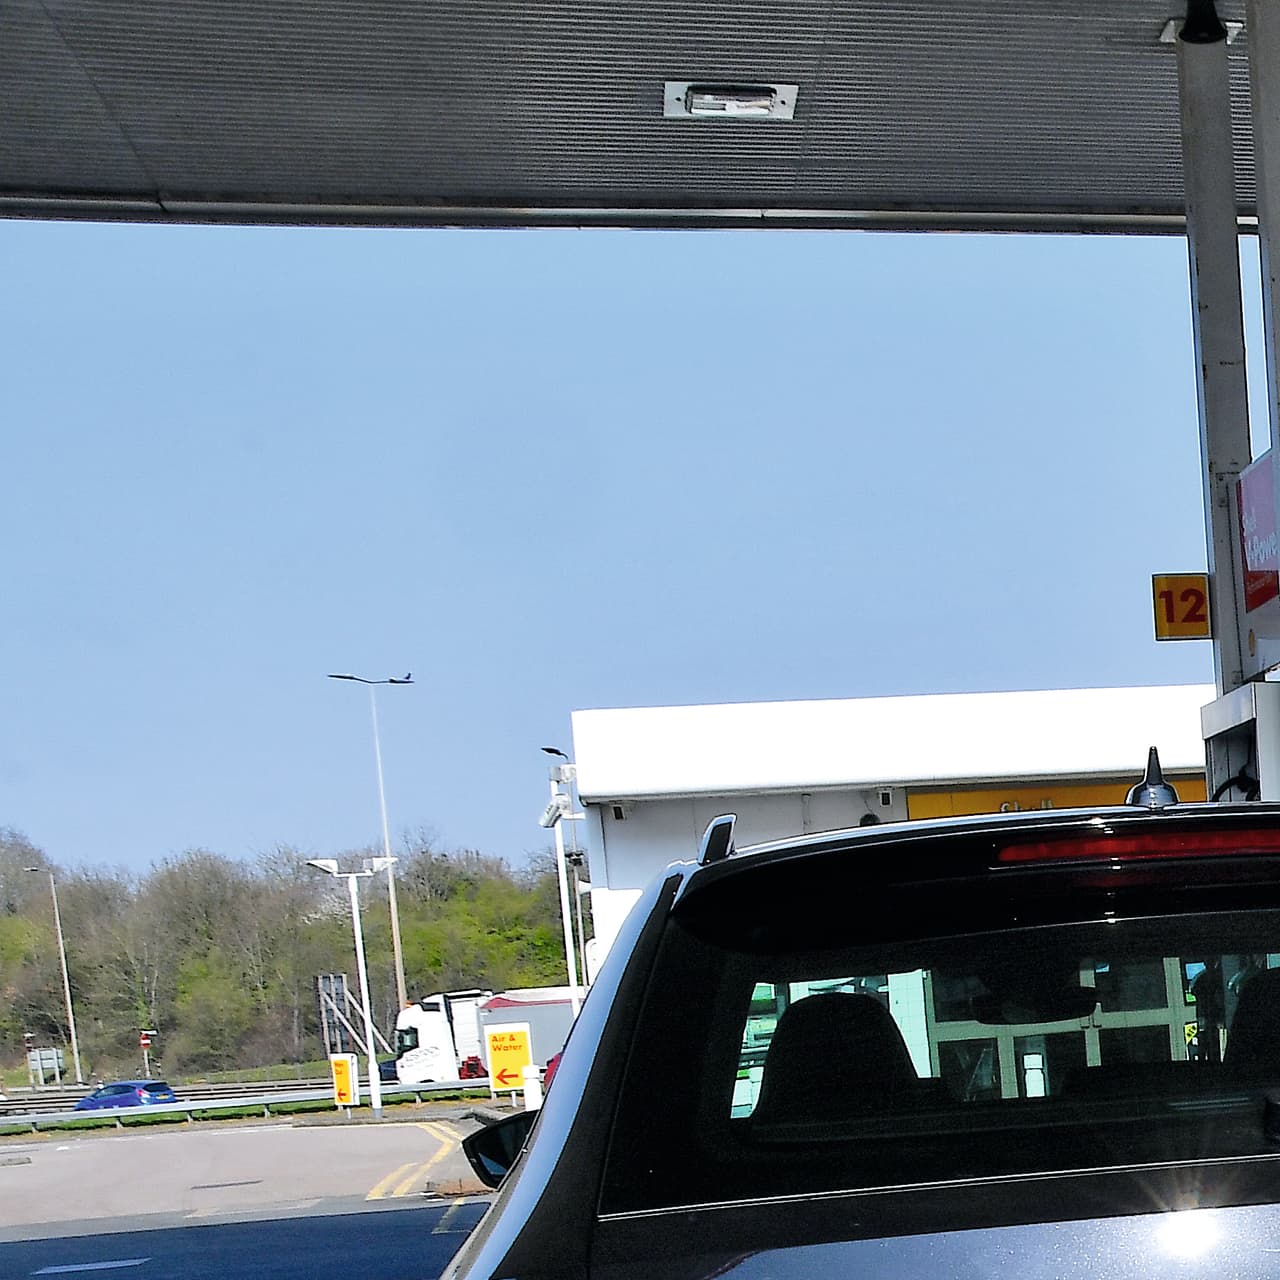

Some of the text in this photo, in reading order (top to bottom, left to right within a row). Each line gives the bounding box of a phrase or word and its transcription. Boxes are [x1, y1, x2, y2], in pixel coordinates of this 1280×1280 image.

[1159, 588, 1206, 623] 12
[492, 1035, 506, 1043] Air
[492, 1042, 523, 1052] Water
